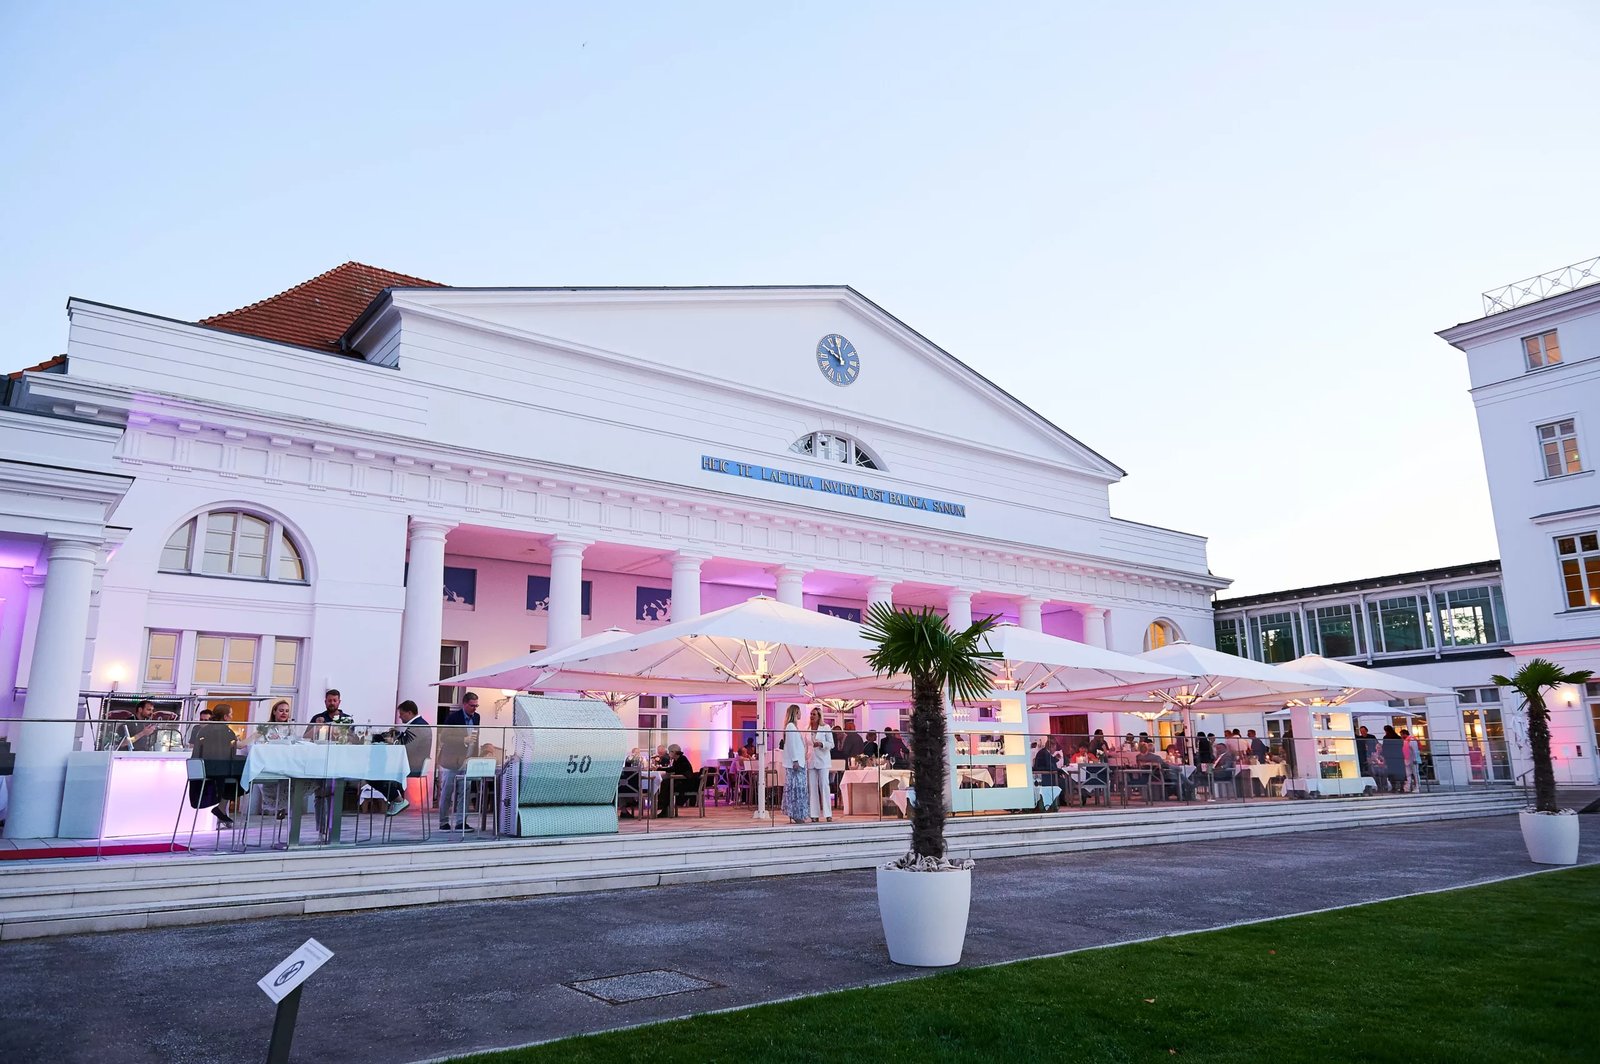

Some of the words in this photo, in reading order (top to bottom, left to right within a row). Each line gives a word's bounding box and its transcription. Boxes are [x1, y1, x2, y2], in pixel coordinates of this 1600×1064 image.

[702, 456, 729, 473] HEIC
[737, 463, 752, 478] TE
[761, 467, 814, 489] LAETITIA
[821, 480, 859, 497] INVITAT
[862, 487, 885, 502] POST
[889, 492, 928, 511] BALNEA
[932, 501, 966, 517] SANUM
[566, 754, 592, 774] 50
